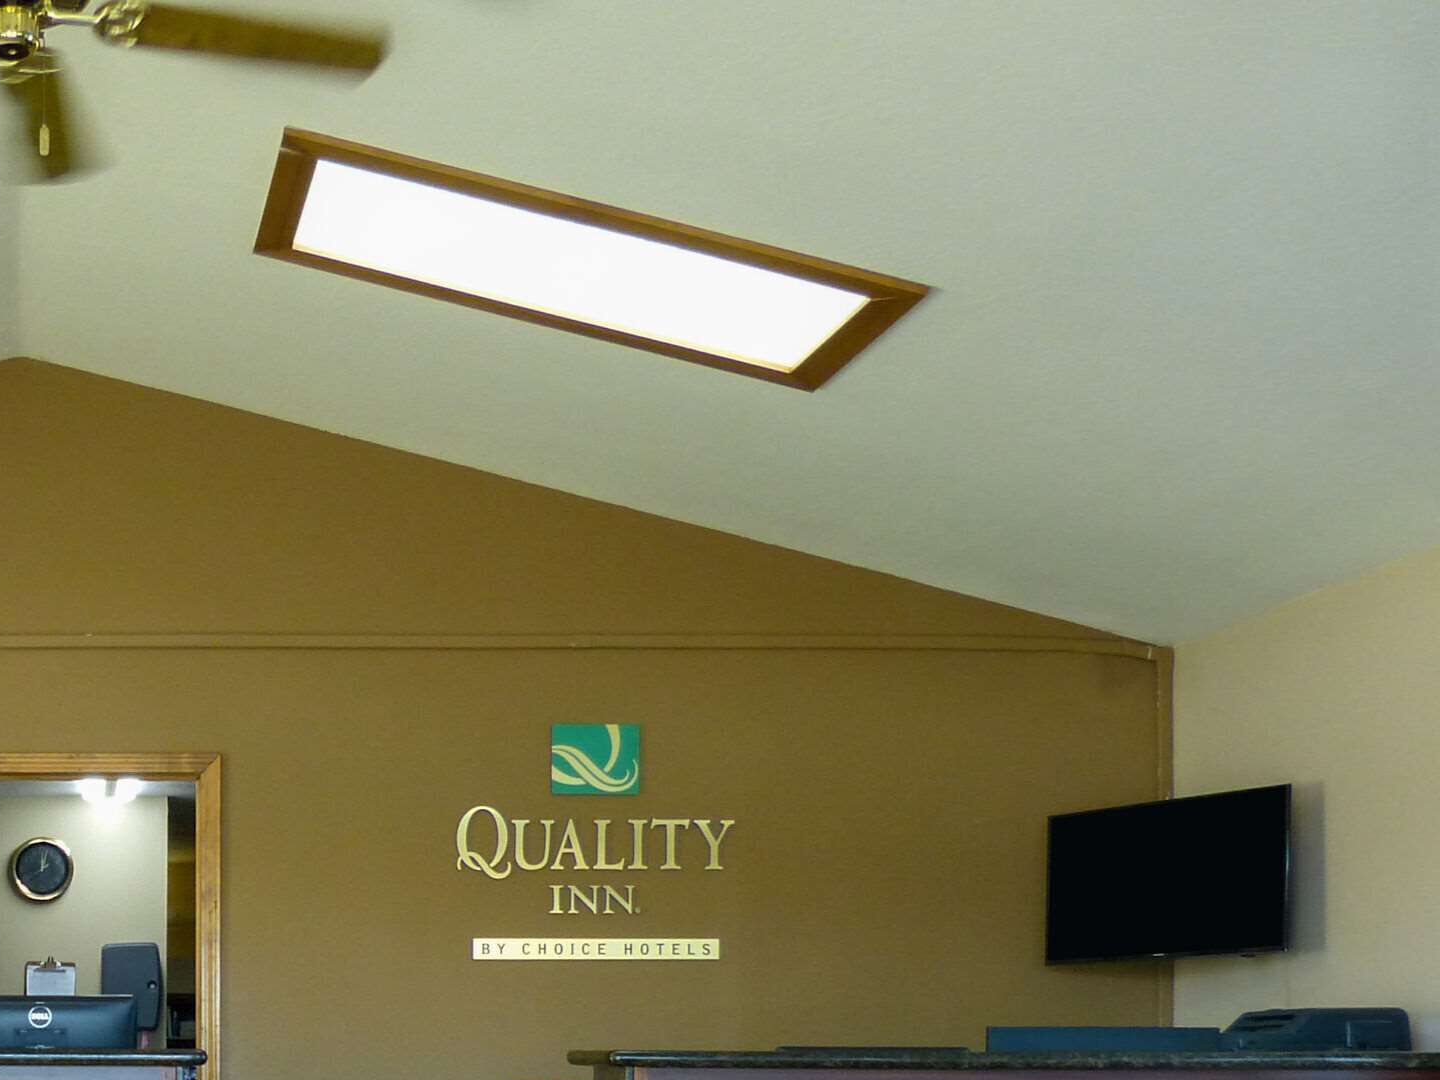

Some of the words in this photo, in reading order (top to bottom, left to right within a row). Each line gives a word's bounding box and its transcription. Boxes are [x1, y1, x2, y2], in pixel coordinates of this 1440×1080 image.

[456, 805, 736, 880] QUALITY
[548, 885, 636, 915] INN
[481, 943, 506, 955] BY
[522, 943, 607, 955] CHOICE
[624, 943, 712, 955] HOTELS
